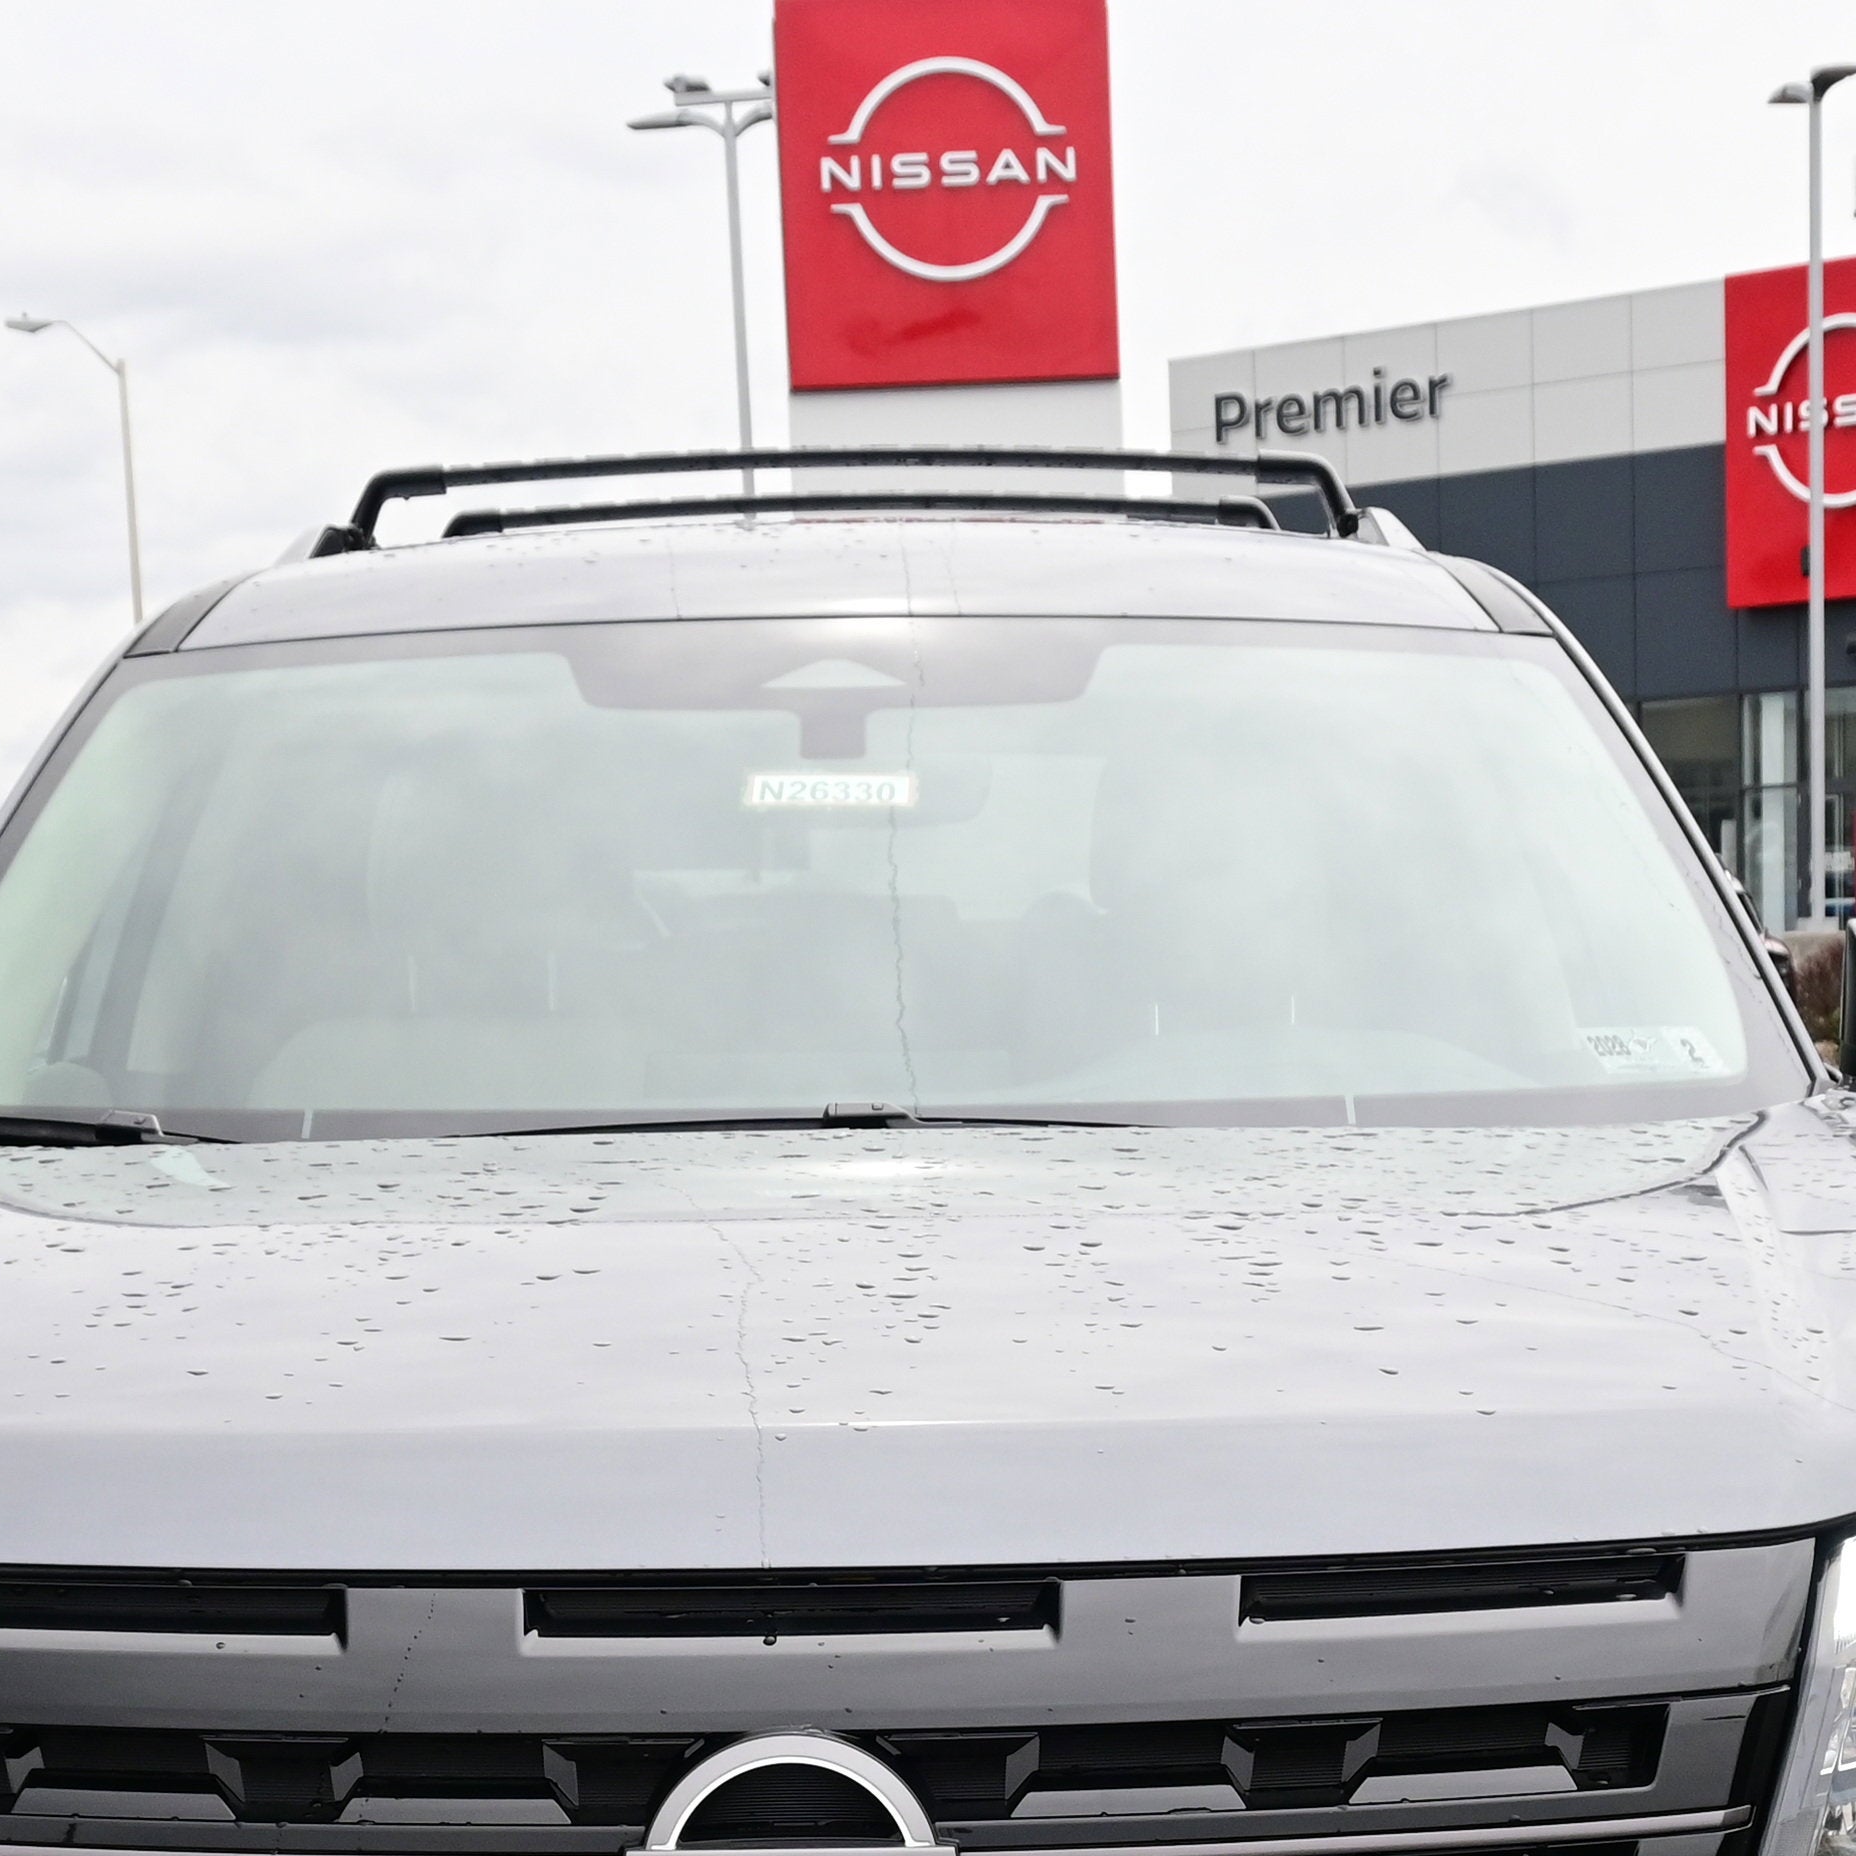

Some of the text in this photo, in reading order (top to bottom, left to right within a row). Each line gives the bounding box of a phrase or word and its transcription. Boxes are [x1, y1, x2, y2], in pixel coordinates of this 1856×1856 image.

[820, 146, 1077, 193] NISSAN
[1214, 366, 1451, 445] Premier
[759, 780, 896, 802] N26330
